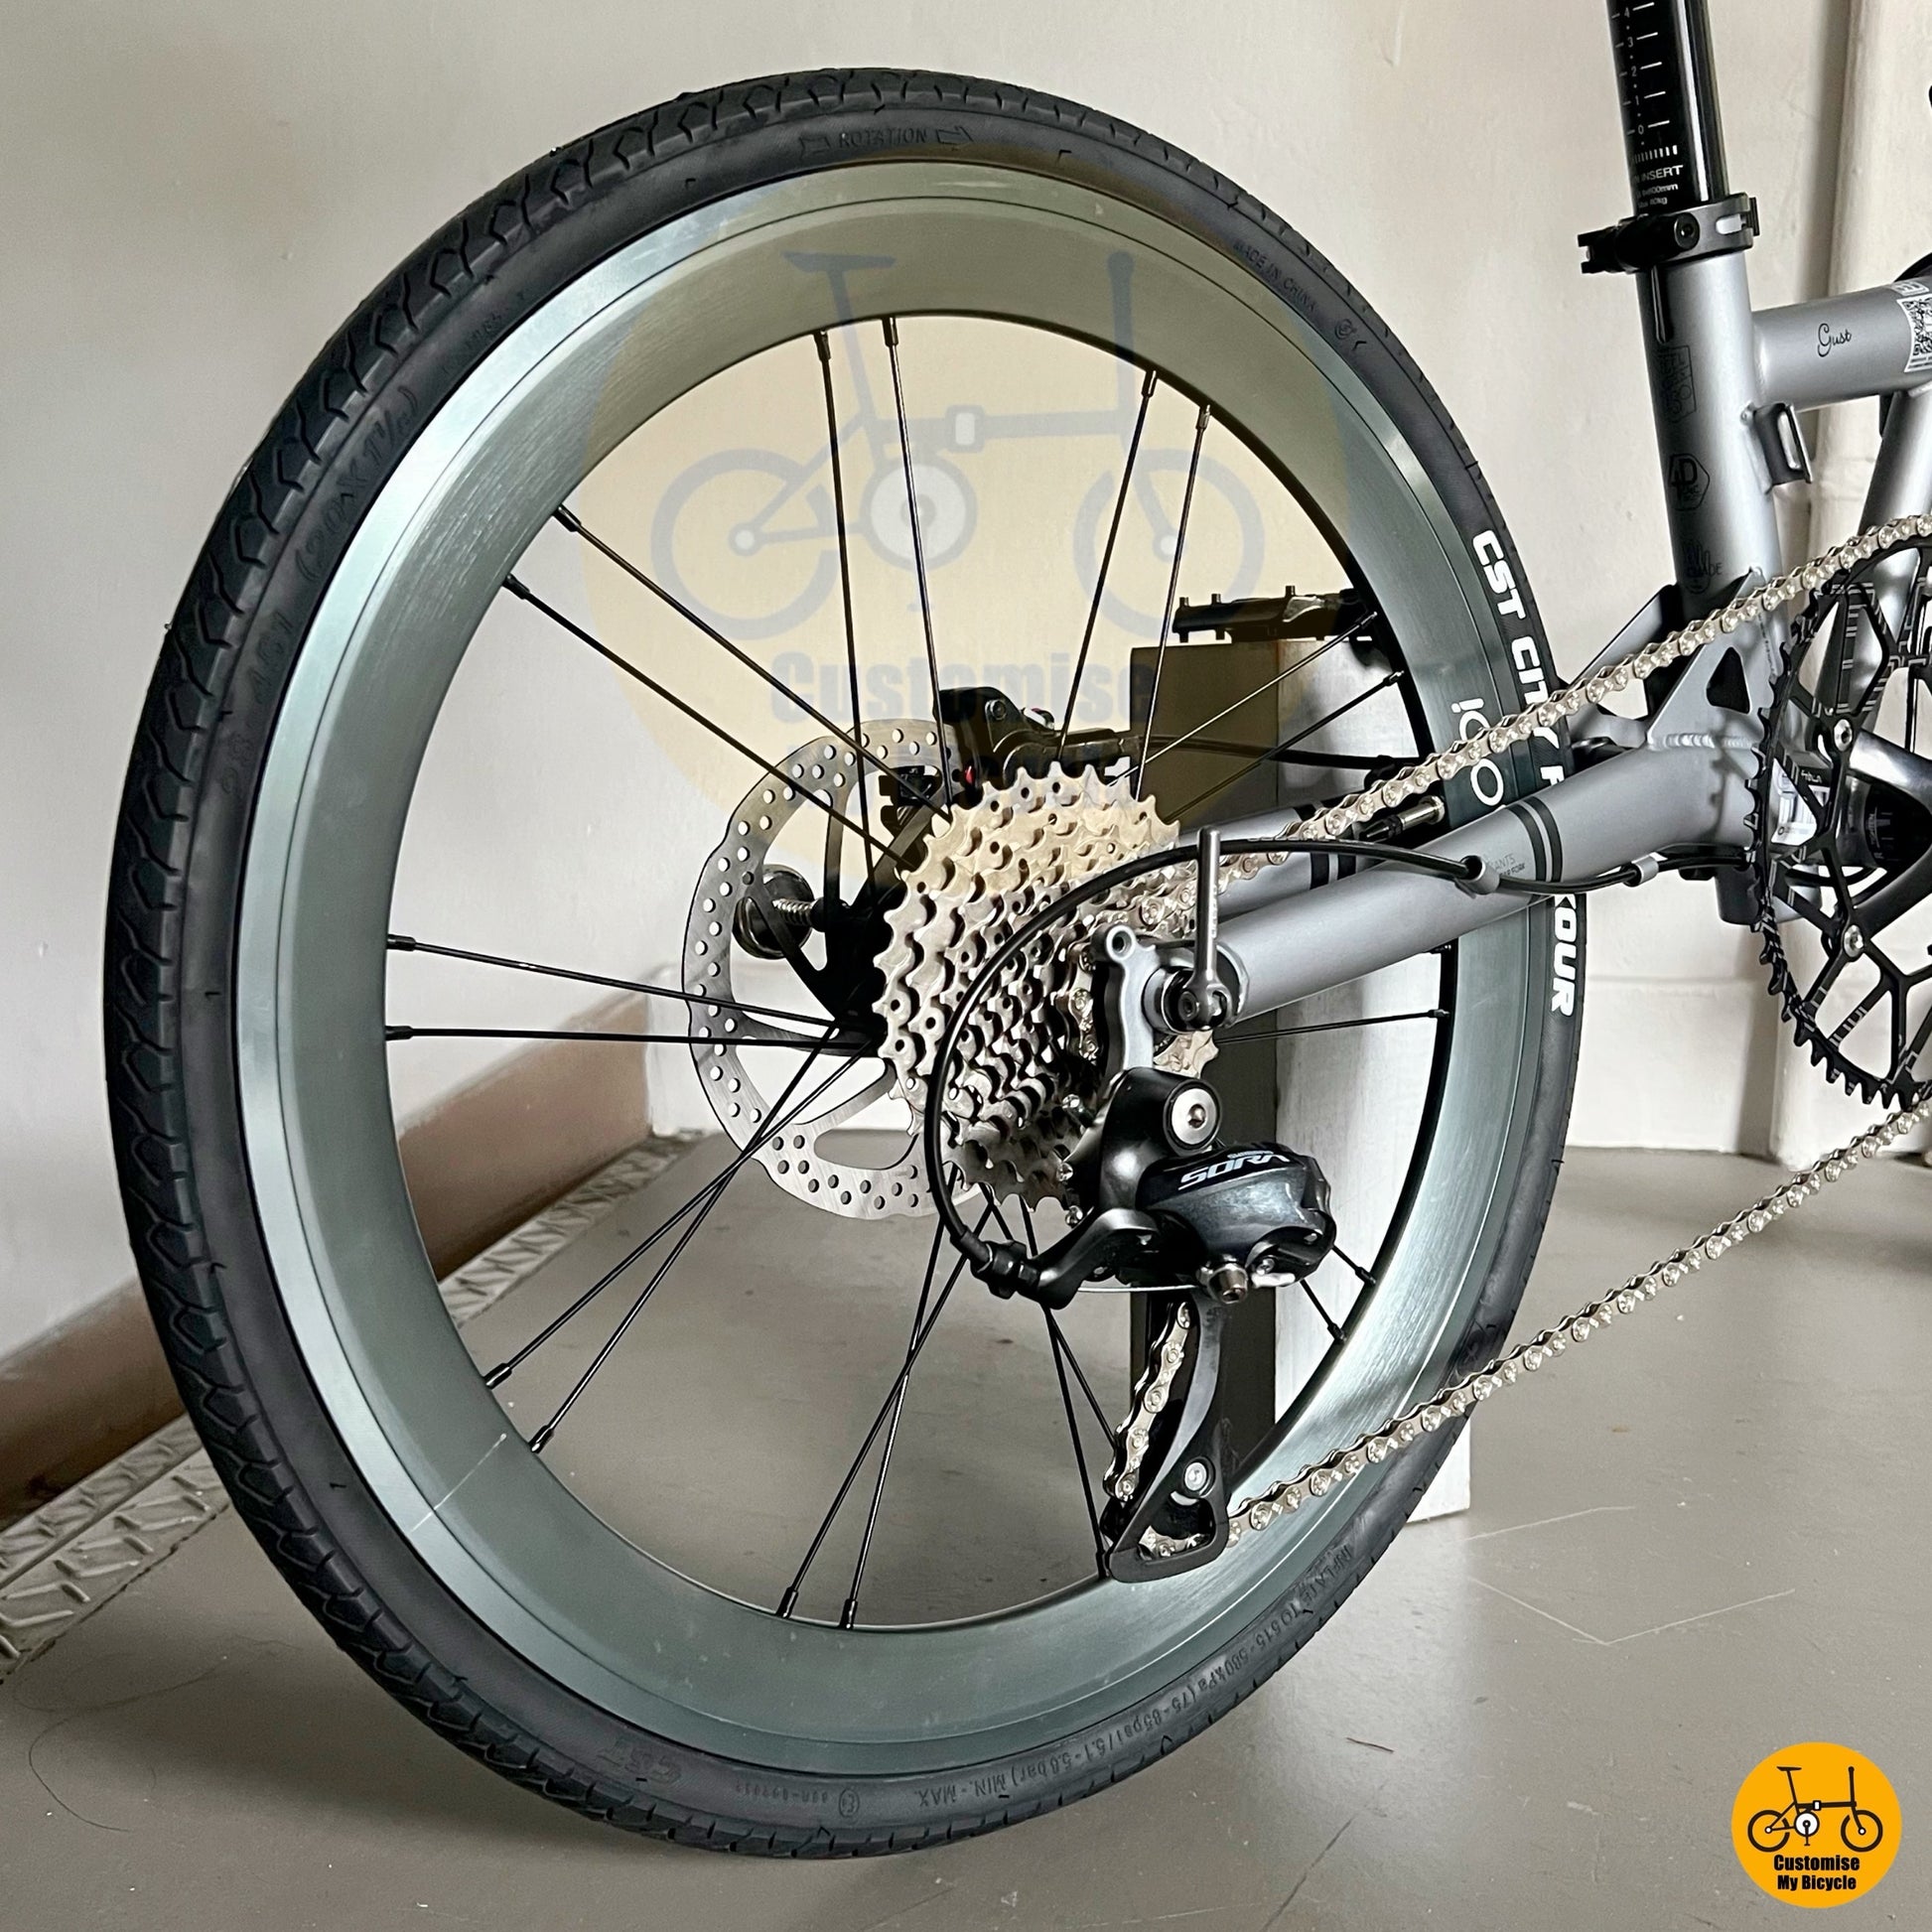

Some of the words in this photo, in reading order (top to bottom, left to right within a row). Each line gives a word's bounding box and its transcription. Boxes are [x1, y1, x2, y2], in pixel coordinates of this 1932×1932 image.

[1627, 37, 1634, 48] 3
[1631, 66, 1637, 76] 2
[837, 126, 927, 150] ROTATION
[1233, 239, 1267, 269] MADE
[1267, 262, 1284, 280] IN
[1283, 276, 1318, 313] CHINA
[1817, 323, 1853, 357] Gust
[1473, 529, 1526, 620] CST
[1177, 1154, 1291, 1190] SORA
